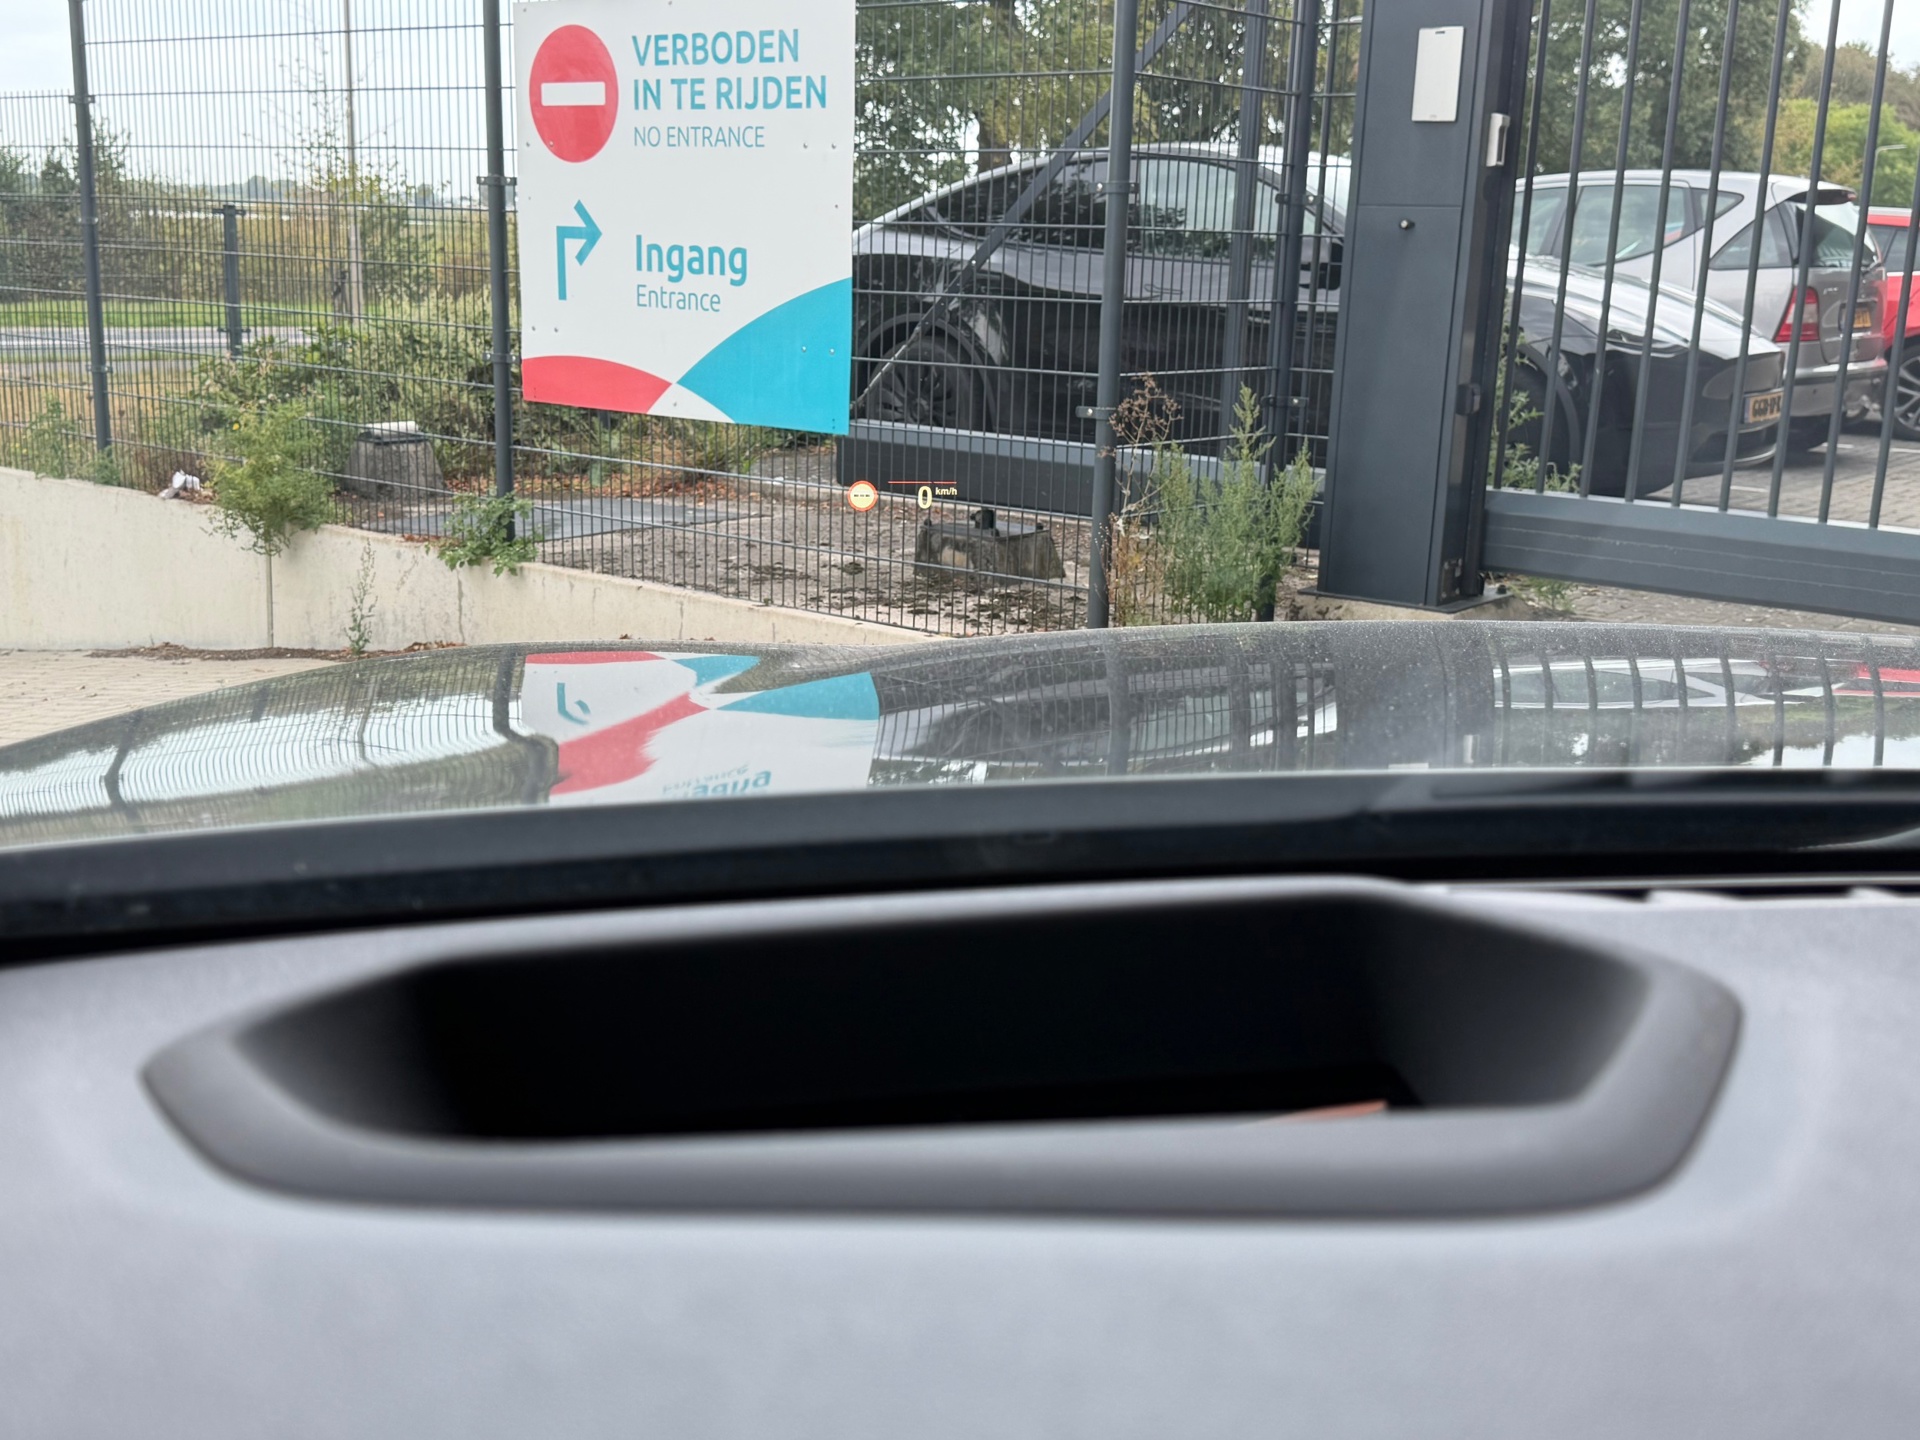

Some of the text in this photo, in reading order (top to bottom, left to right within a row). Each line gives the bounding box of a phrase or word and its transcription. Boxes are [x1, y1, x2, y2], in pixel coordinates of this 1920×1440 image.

[632, 29, 799, 66] VERBODEN
[634, 75, 827, 111] IN TE RIJDEN
[634, 126, 765, 148] NO ENTRANCE
[636, 234, 748, 287] Ingang
[636, 284, 721, 313] Entrance
[917, 486, 957, 509] 0 km/h
